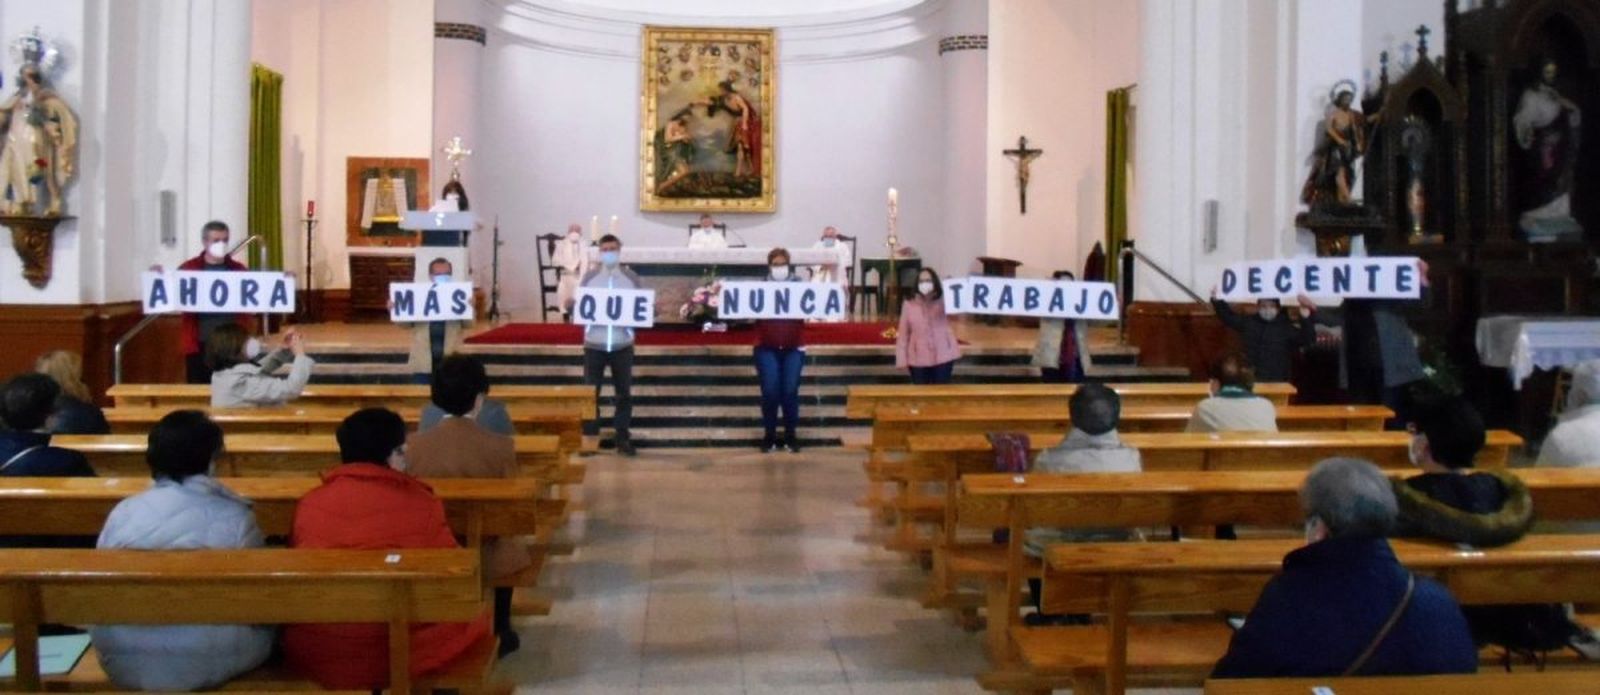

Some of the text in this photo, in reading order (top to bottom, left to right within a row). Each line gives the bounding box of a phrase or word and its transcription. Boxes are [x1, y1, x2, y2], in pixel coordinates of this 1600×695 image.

[149, 276, 289, 309] AHORA
[1220, 263, 1414, 296] DECENTE
[393, 284, 468, 317] MÁS
[578, 294, 648, 323] QUE
[722, 286, 841, 316] NUNCA
[948, 282, 1115, 316] TRABAJO
